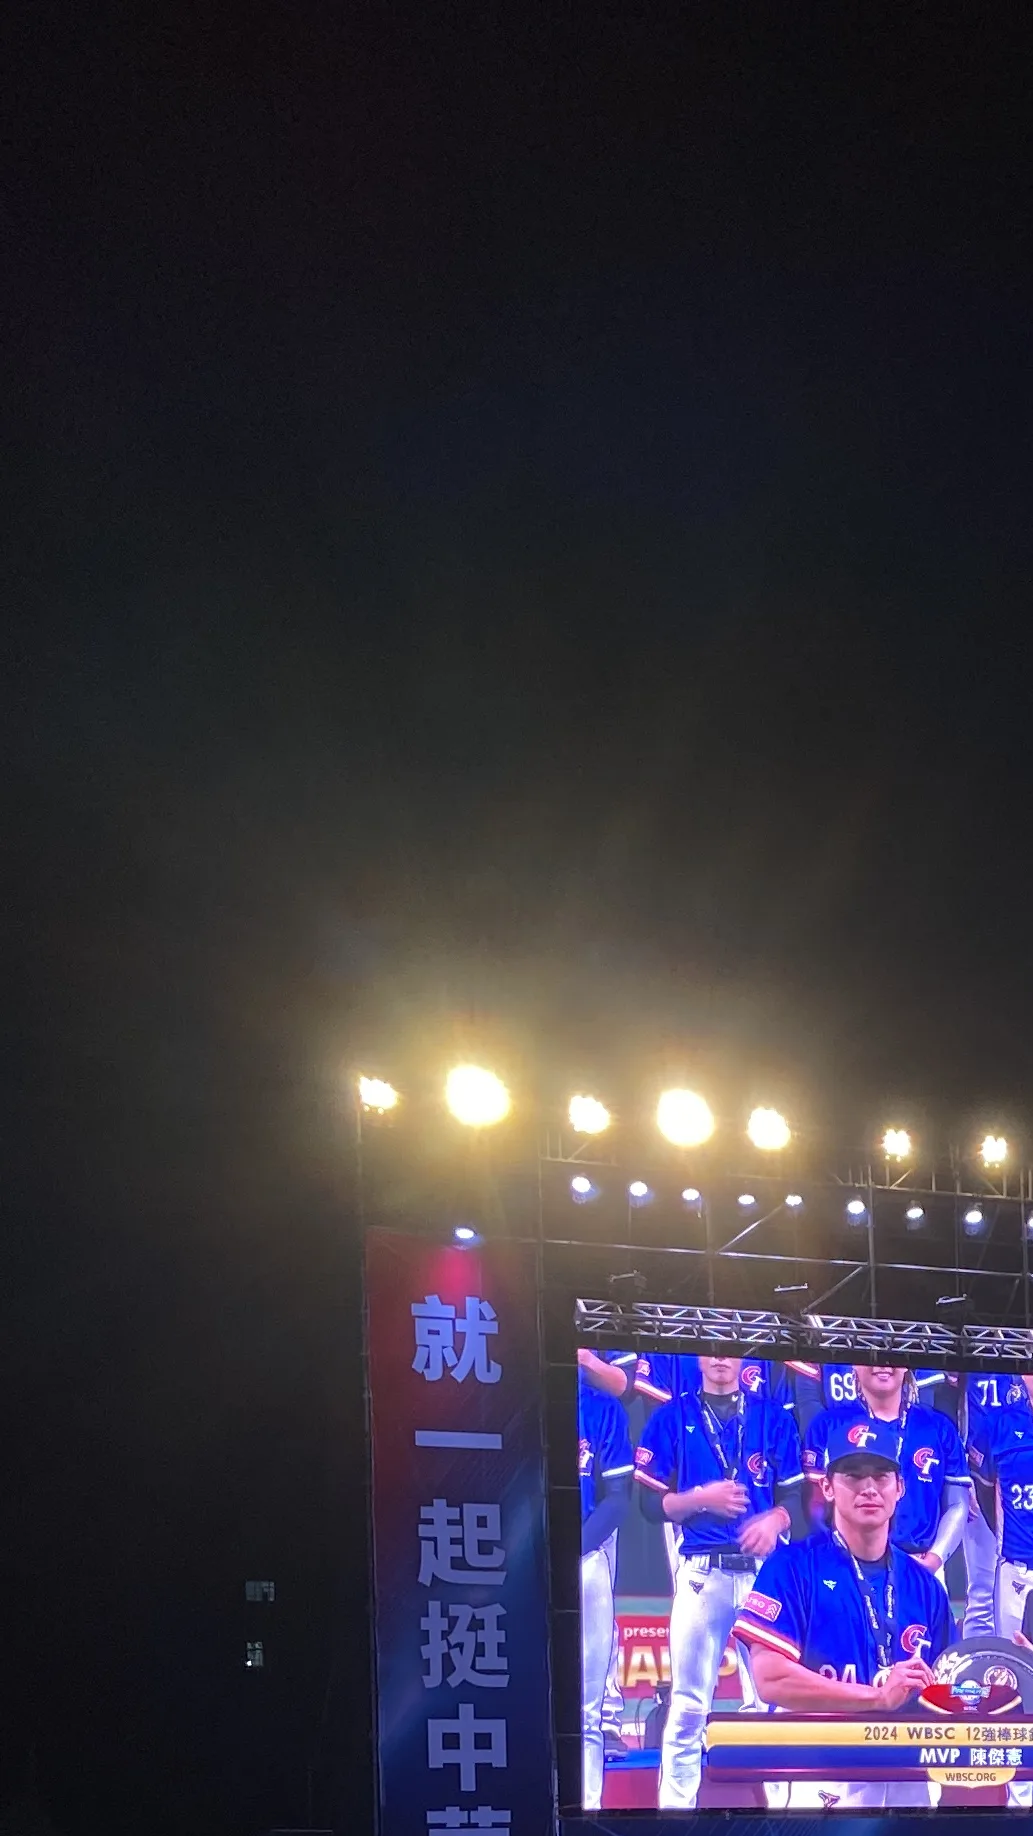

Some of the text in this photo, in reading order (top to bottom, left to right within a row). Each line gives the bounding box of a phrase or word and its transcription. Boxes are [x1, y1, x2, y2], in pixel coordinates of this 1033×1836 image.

[830, 1372, 857, 1402] 69
[977, 1380, 1001, 1407] 71
[864, 1726, 897, 1741] 2024
[907, 1726, 956, 1740] WBSC
[919, 1747, 1023, 1766] MVP 陳傑憲
[945, 1772, 996, 1782] WBSC.ORG
